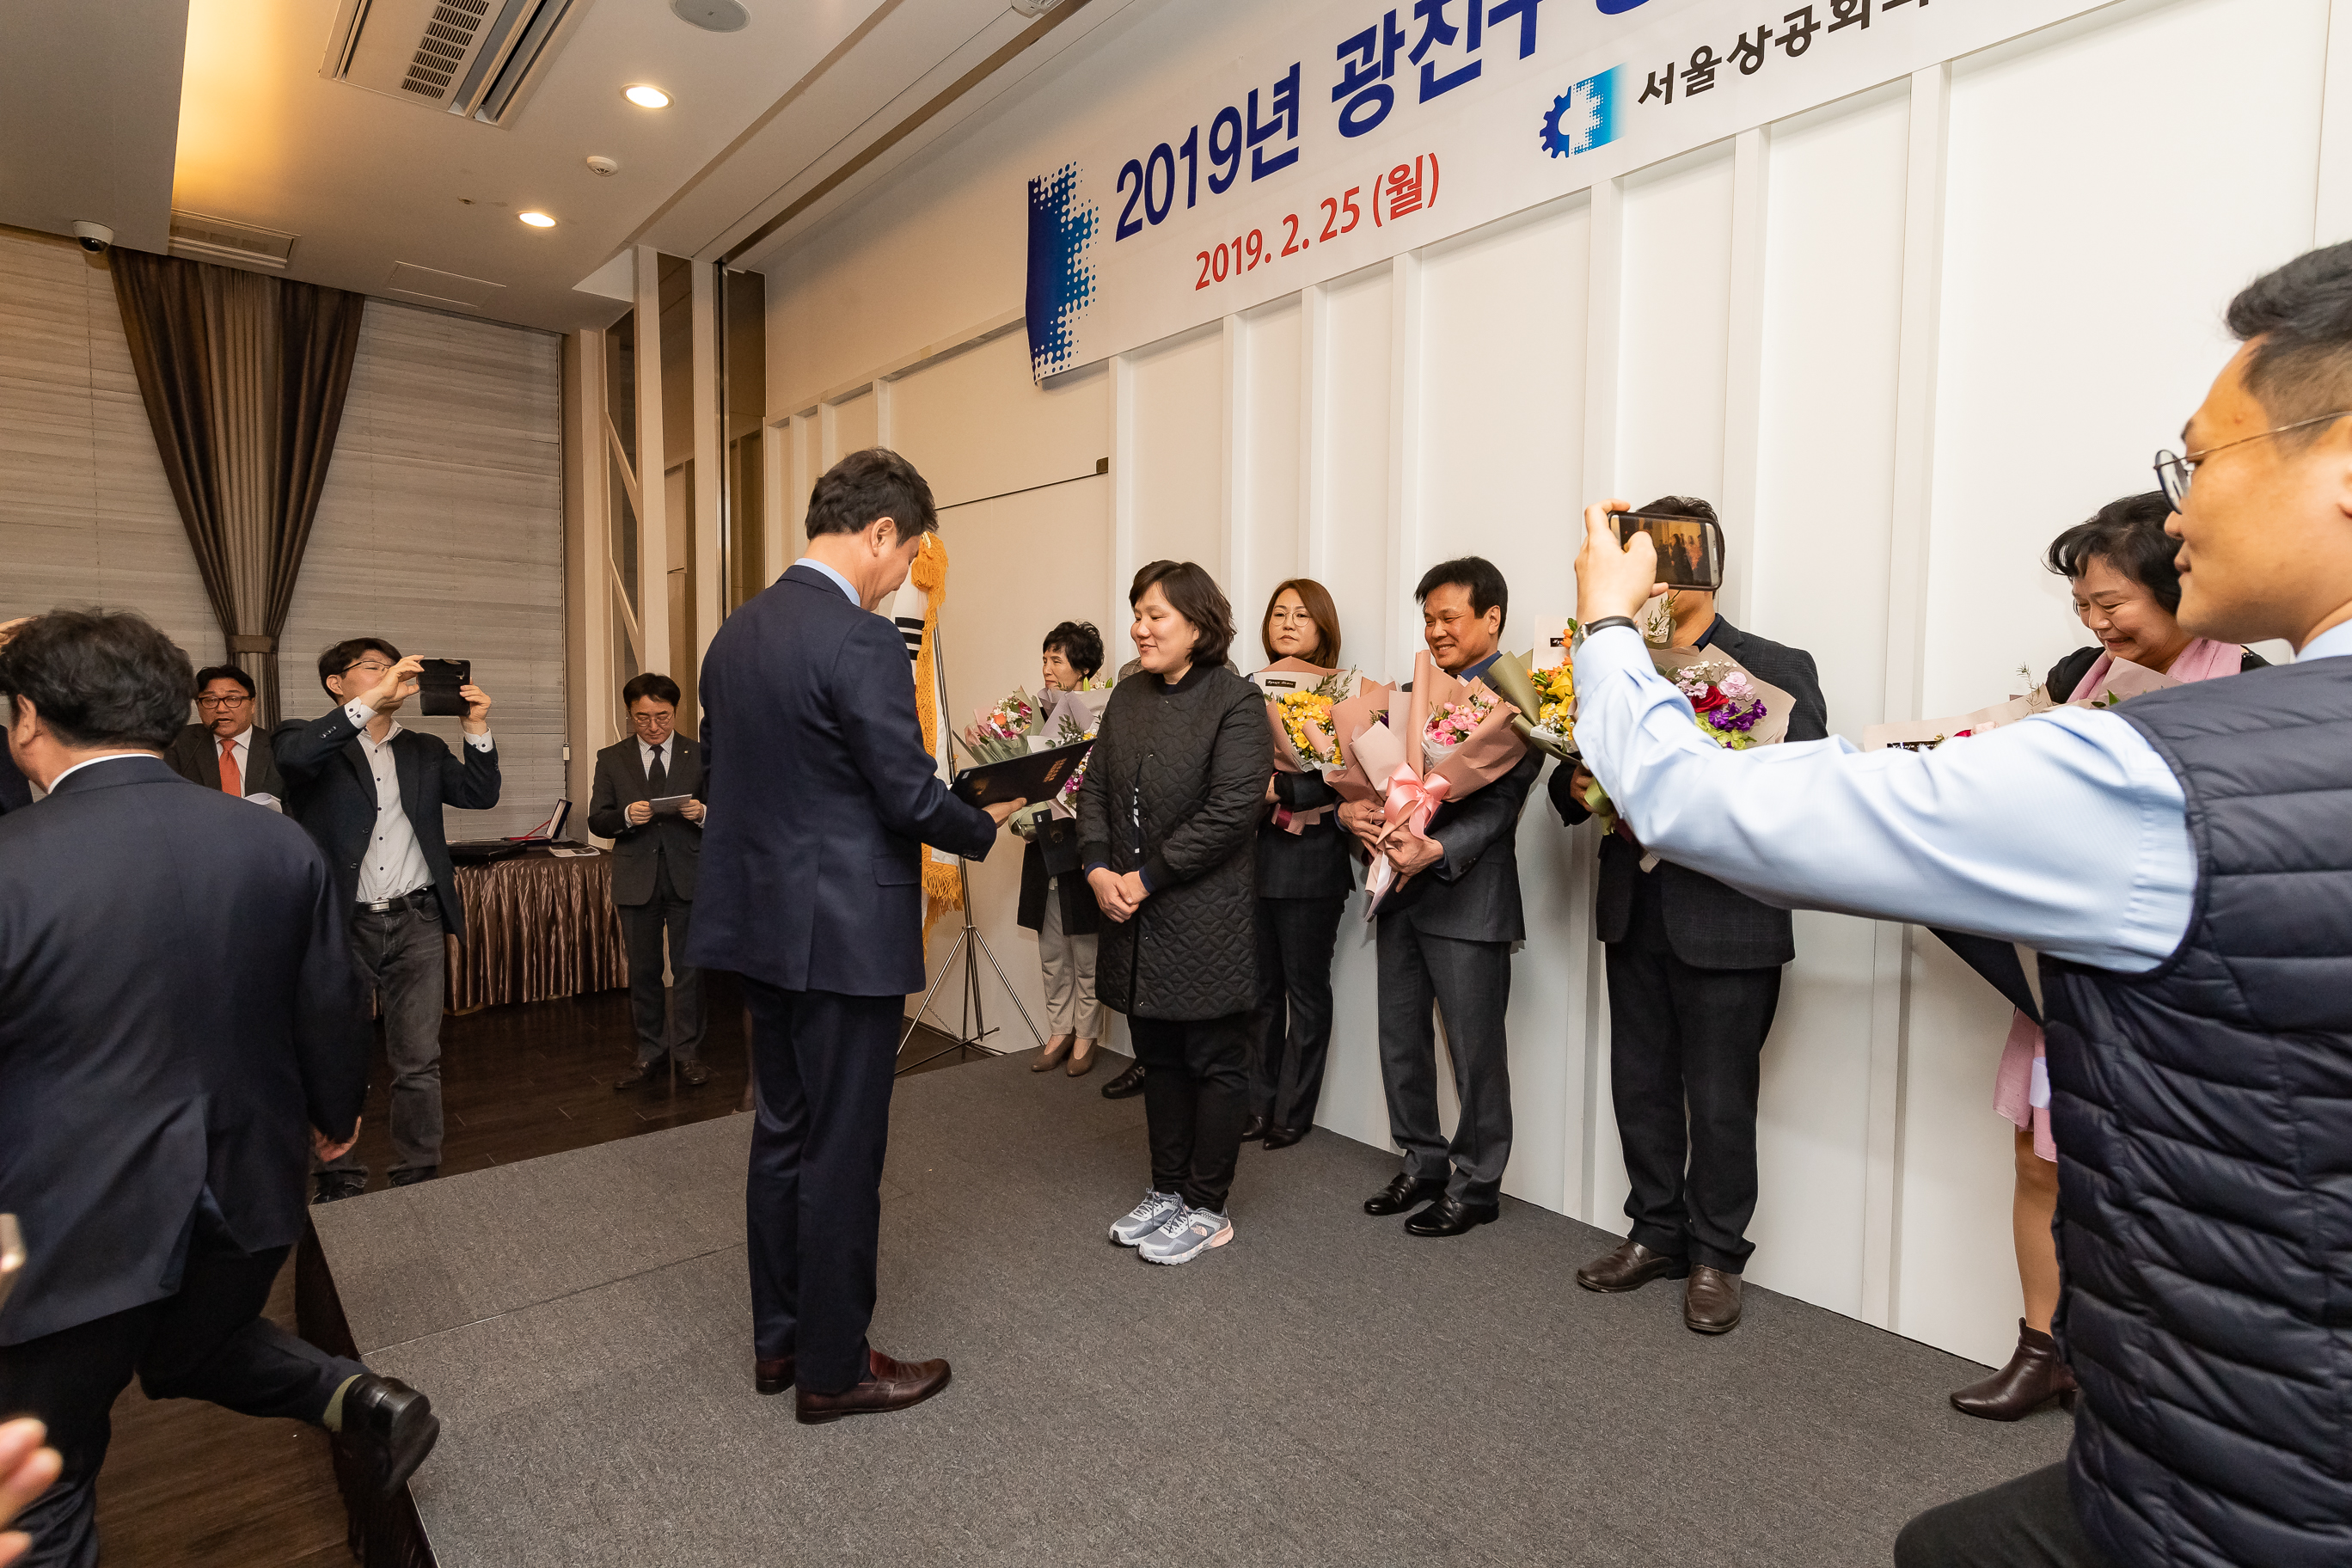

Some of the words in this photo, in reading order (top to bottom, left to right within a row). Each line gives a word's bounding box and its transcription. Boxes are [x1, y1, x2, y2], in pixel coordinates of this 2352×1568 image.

[1115, 62, 1301, 242] 2019년
[1195, 229, 1271, 291] 2019.
[1281, 213, 1309, 258] 2.
